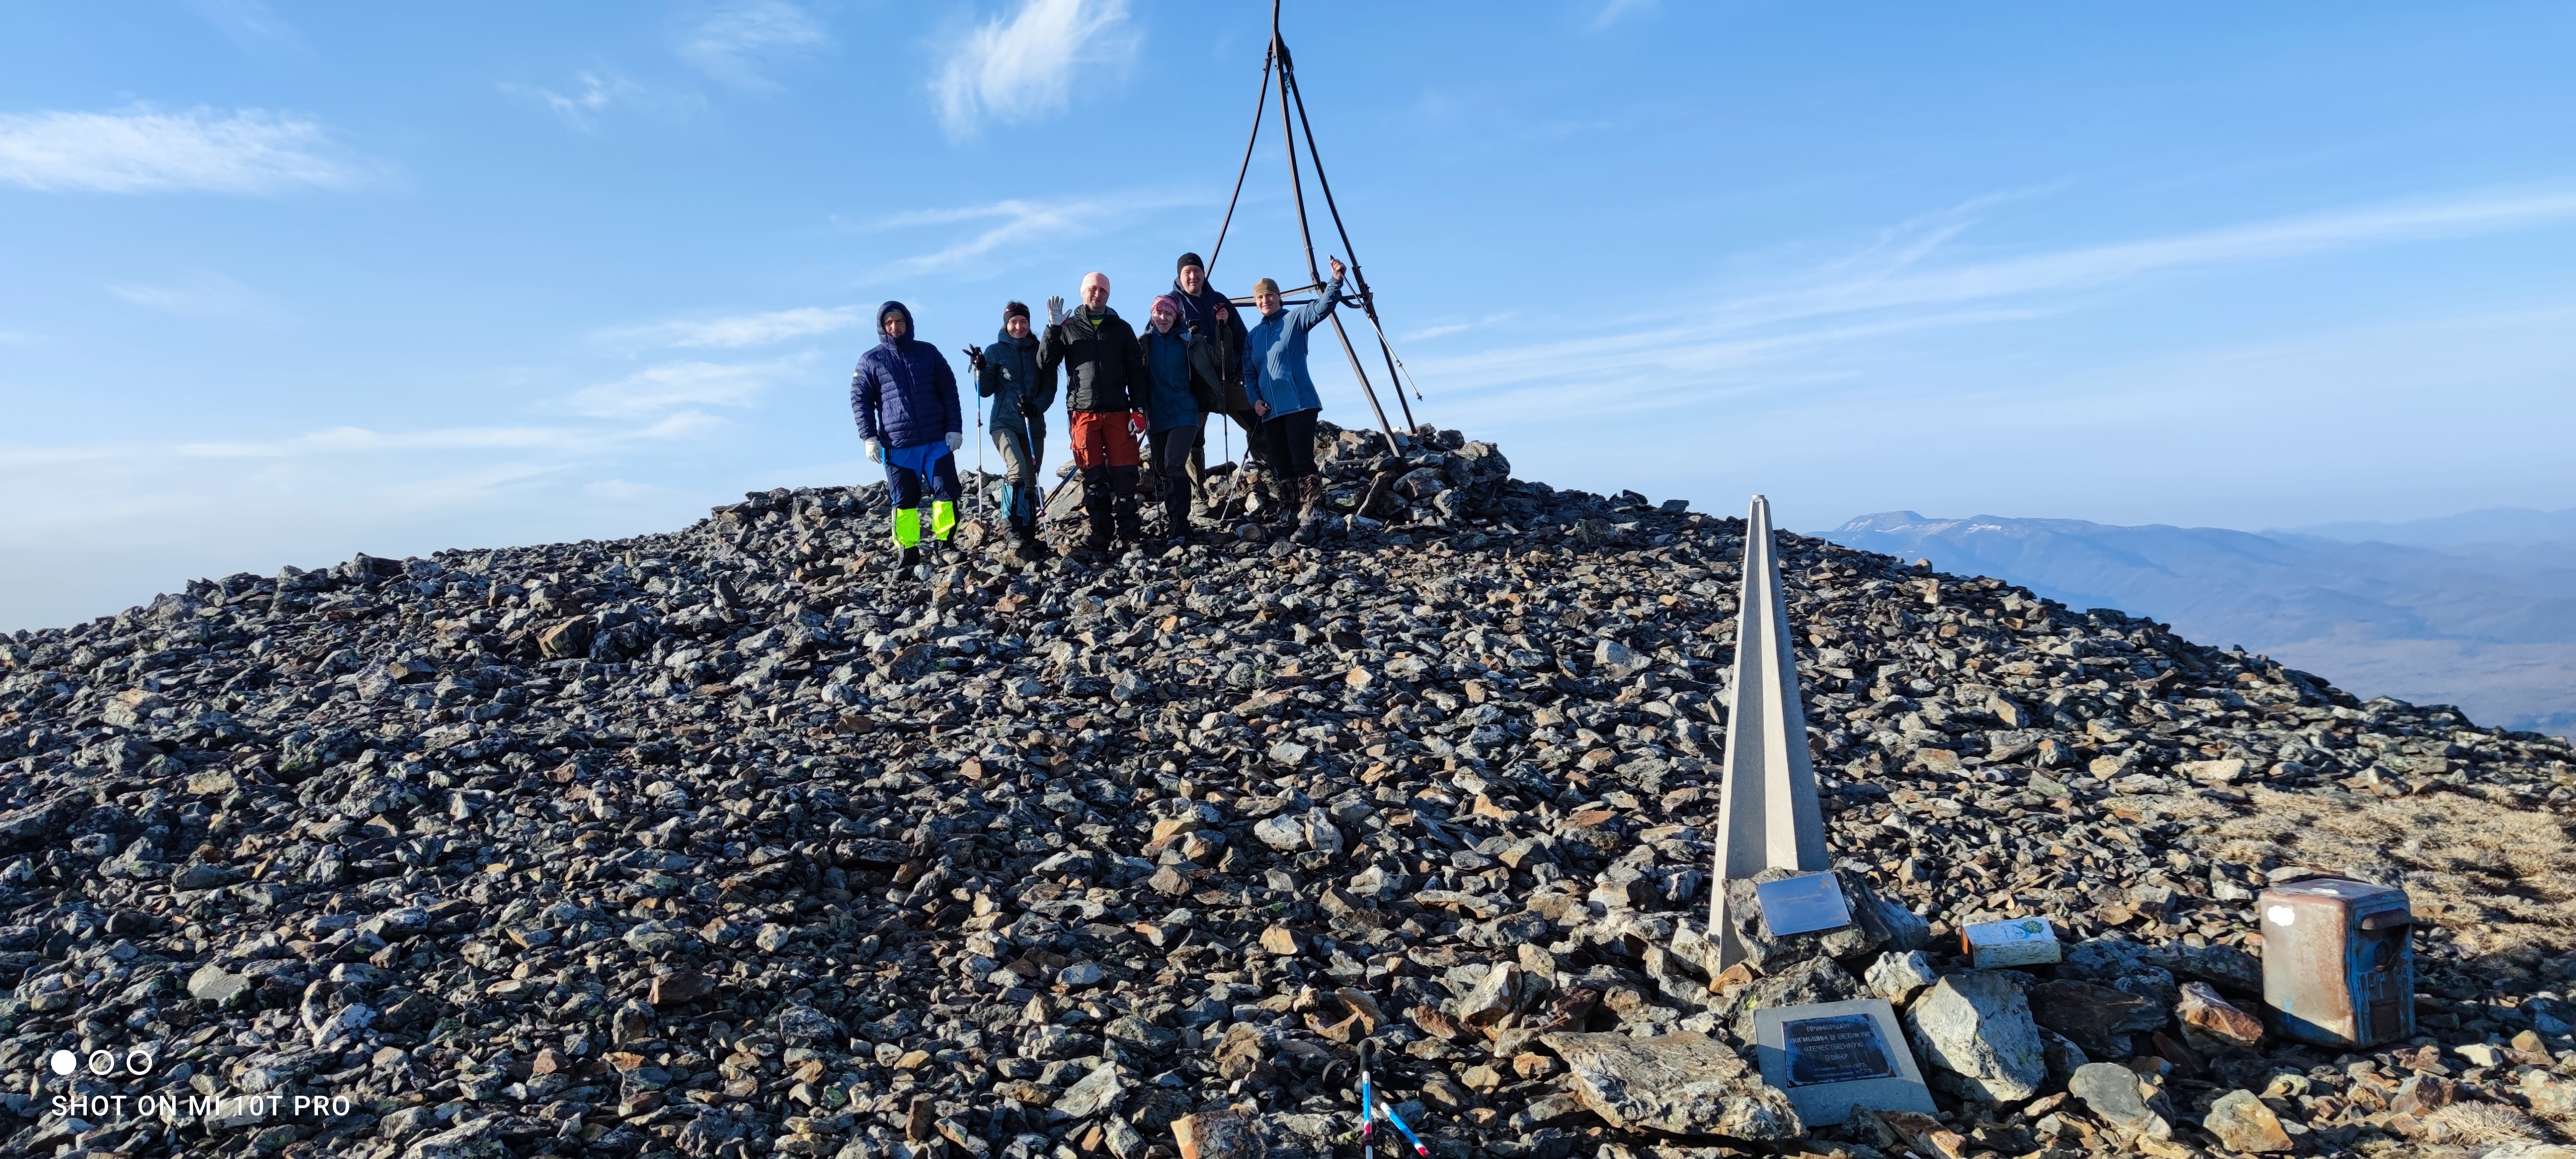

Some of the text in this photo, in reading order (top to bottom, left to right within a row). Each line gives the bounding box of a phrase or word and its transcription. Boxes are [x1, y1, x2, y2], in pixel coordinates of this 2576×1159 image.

[1806, 1023, 1850, 1032] ПРИМОРЦАМ
[1789, 1035, 1828, 1044] ПОГИБШИМ
[1837, 1031, 1870, 1040] ВЕЛИКУЮ
[1804, 1041, 1864, 1052] ОТЕЧЕСТВЕННУЮ
[1824, 1053, 1848, 1062] ВОЙНУ
